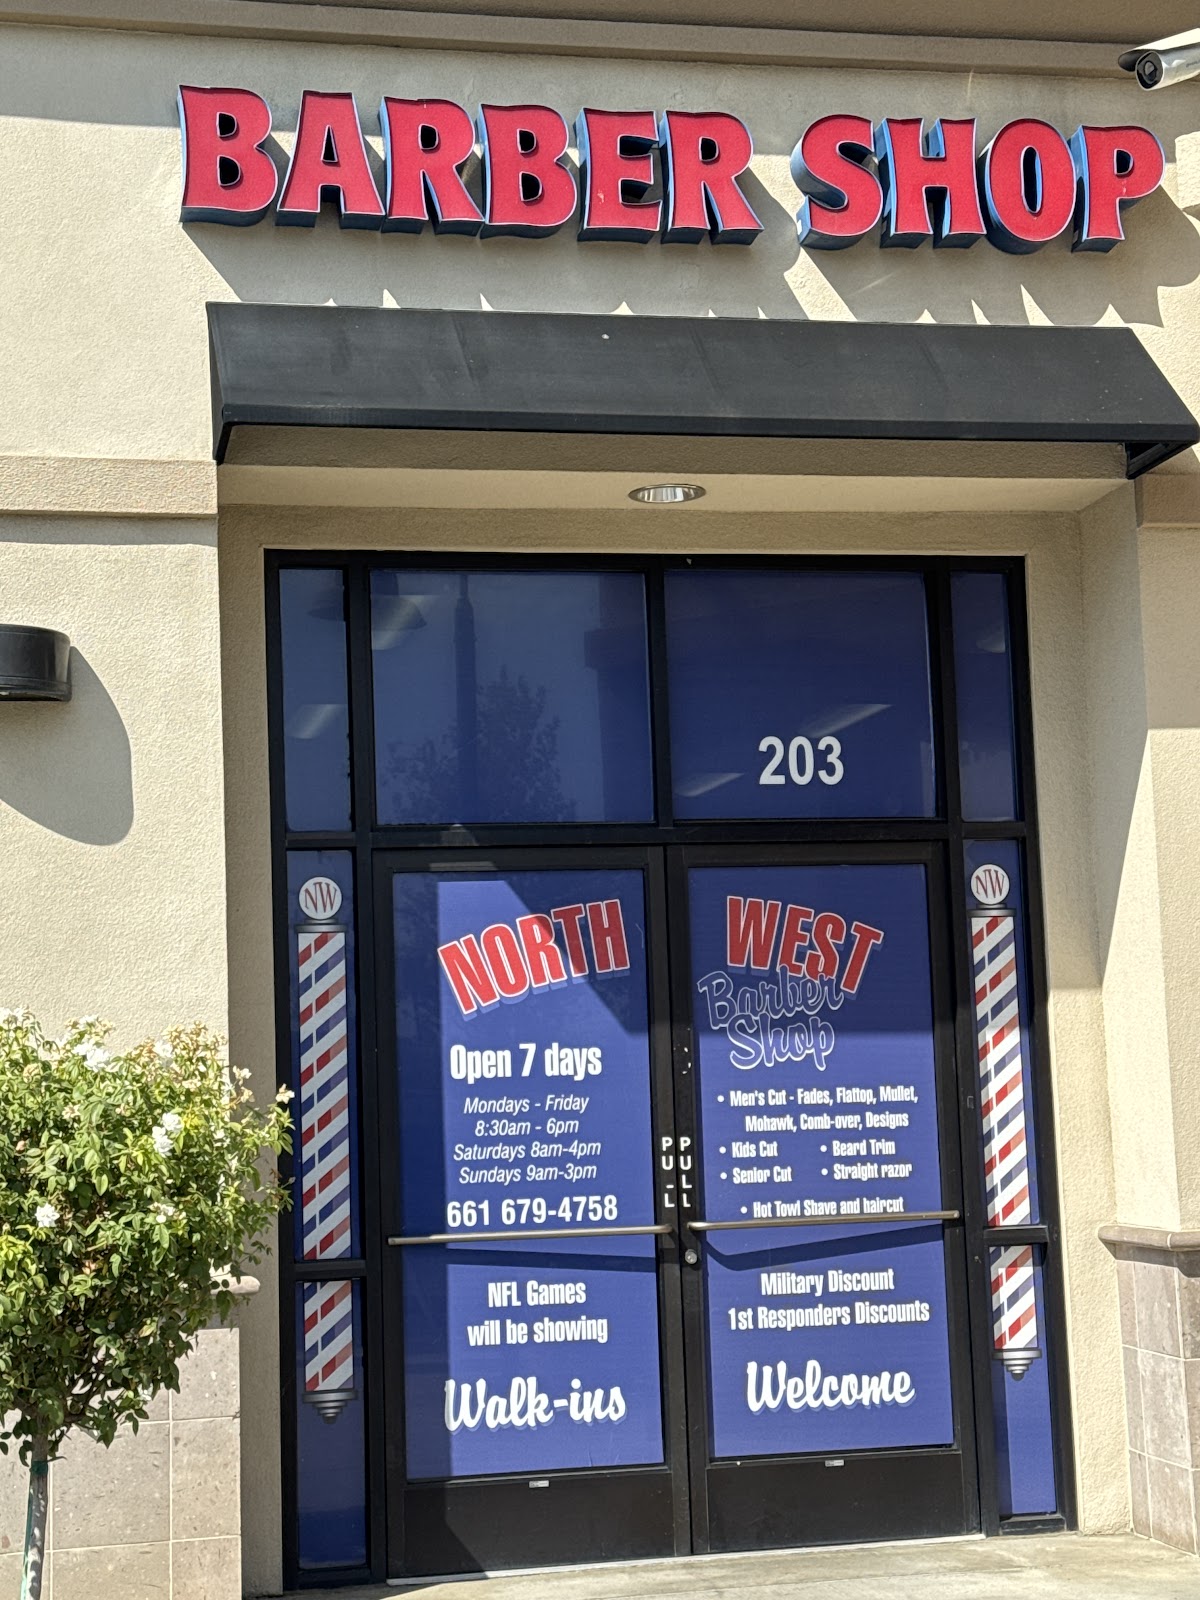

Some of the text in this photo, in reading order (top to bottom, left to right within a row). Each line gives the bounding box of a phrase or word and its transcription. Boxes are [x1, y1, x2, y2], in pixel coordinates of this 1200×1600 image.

[178, 84, 1166, 251] BARBER SHOP
[758, 735, 844, 786] 203
[303, 881, 338, 913] NW
[975, 868, 1005, 899] NW
[437, 898, 630, 1017] NORTH
[726, 895, 885, 994] WEST
[697, 963, 845, 1030] Barber
[726, 1012, 835, 1071] Shop
[450, 1042, 602, 1084] Open 7 days
[463, 1096, 530, 1116] Mondays
[545, 1094, 589, 1114] Friday
[729, 1089, 765, 1107] Men's
[767, 1088, 787, 1106] Cut
[797, 1088, 833, 1107] Fades,
[836, 1087, 877, 1105] Flattop,
[879, 1085, 918, 1104] Mullet,
[474, 1119, 531, 1137] 8:30am
[546, 1118, 579, 1137] 6pm
[745, 1111, 909, 1133] Mohawk, Comb-over, Designs
[453, 1140, 601, 1162] Saturdays 8am-4pm
[731, 1140, 778, 1158] Kids Cut
[832, 1138, 896, 1157] Beard Trim
[459, 1163, 597, 1186] Sundays 9am-3pm
[679, 1136, 693, 1208] PULL
[732, 1166, 792, 1184] Senior Cut
[833, 1162, 913, 1181] Straight razor
[447, 1194, 618, 1228] 661 679-4758
[753, 1196, 904, 1218] Hot Towl Shave and haircut
[487, 1280, 587, 1308] NFL Games
[760, 1268, 895, 1297] Military Discount
[467, 1315, 608, 1346] will be showing
[728, 1300, 930, 1332] 1st Responders Discounts
[746, 1359, 916, 1413] Welcome
[444, 1376, 627, 1432] Walk-ins
